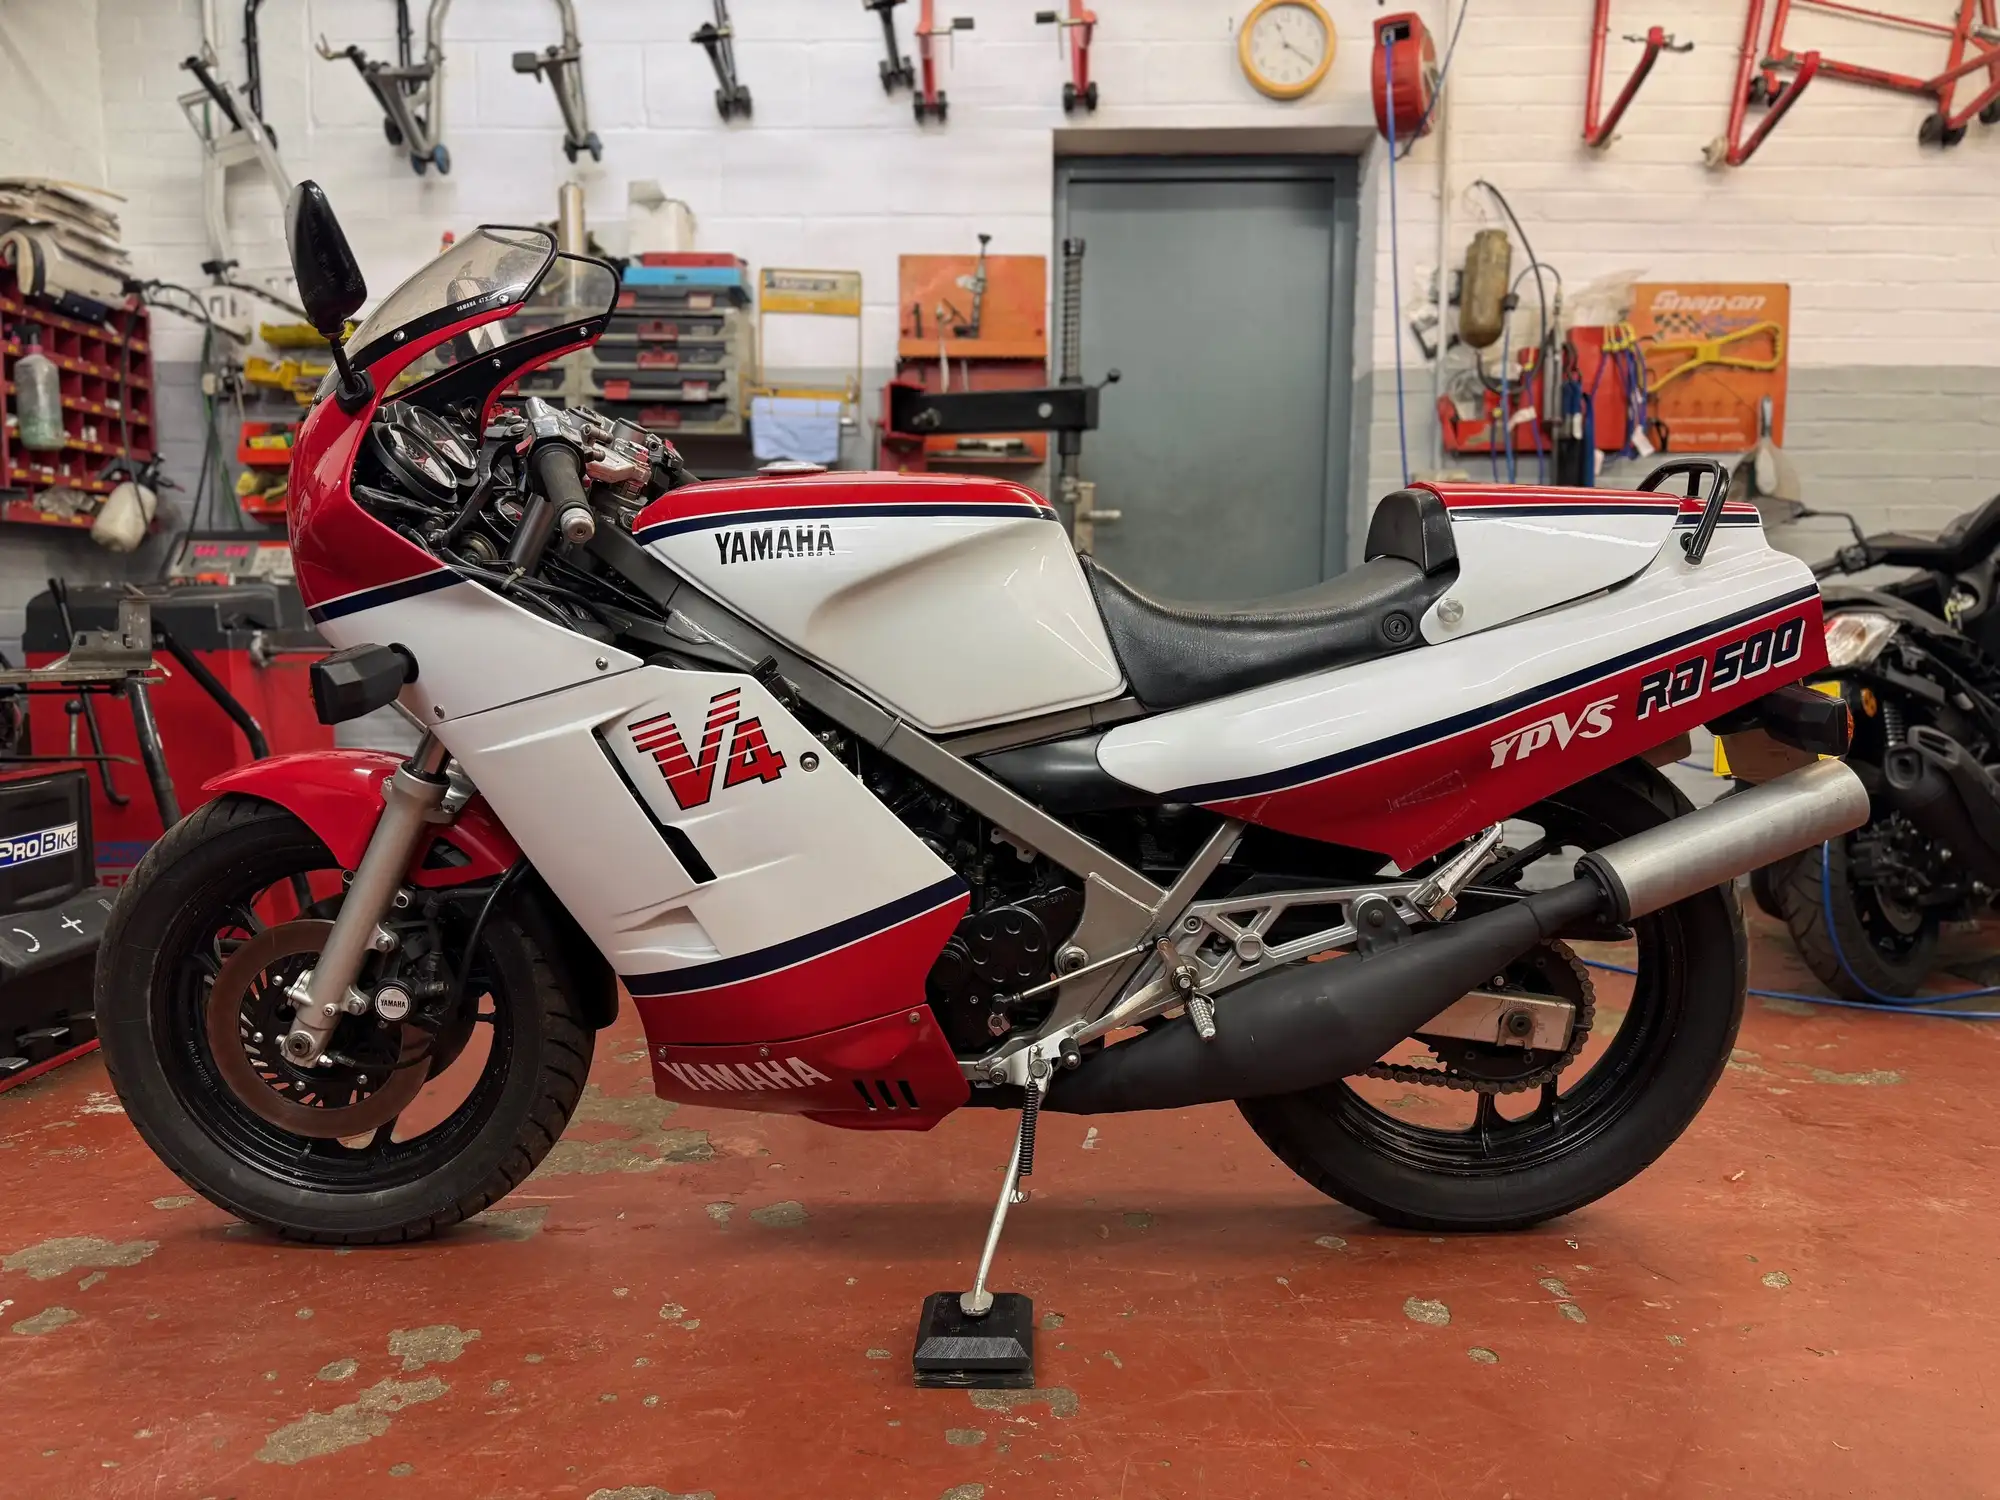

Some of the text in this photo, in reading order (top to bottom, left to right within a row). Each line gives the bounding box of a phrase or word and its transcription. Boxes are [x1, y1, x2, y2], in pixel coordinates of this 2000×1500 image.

[456, 301, 477, 312] YAMAHA
[714, 524, 835, 565] YAMAHA
[1490, 617, 1806, 769] YPVS RD 500
[627, 686, 787, 811] V4
[380, 999, 406, 1009] YAMAHA
[658, 1056, 832, 1091] YAMAHA
